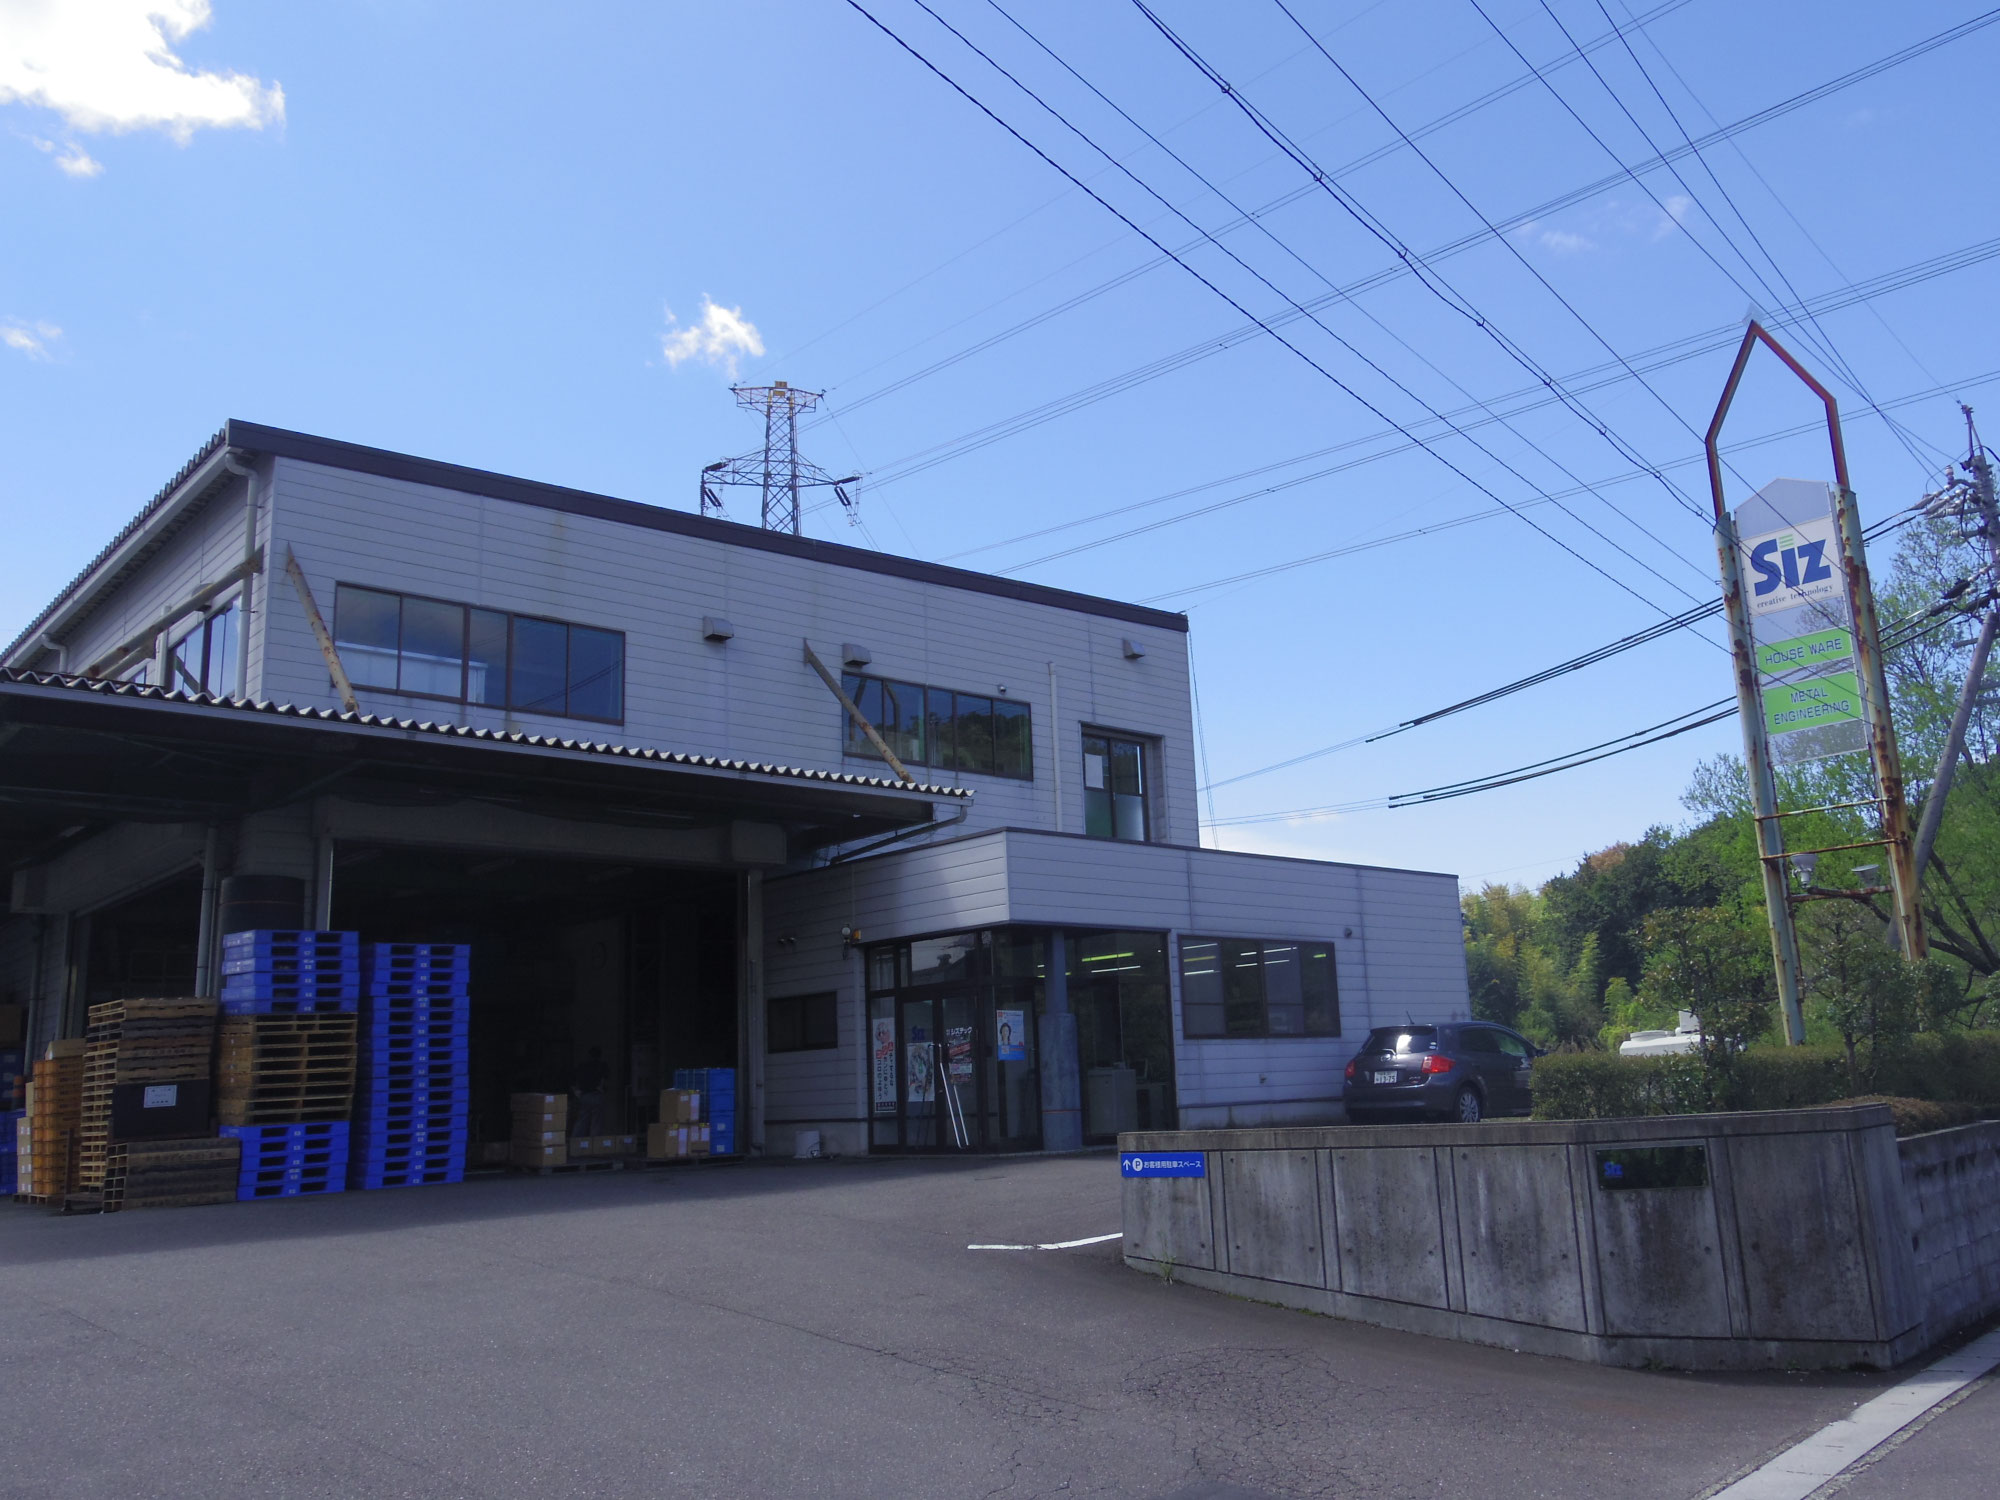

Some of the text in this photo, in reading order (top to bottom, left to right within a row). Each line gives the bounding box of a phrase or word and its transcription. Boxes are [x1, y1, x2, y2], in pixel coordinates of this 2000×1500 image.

[1756, 585, 1833, 609] creative tehnology
[1765, 638, 1843, 665] HOUSE WARE
[1790, 687, 1828, 703] METAL
[1773, 700, 1850, 725] ENGINEERING
